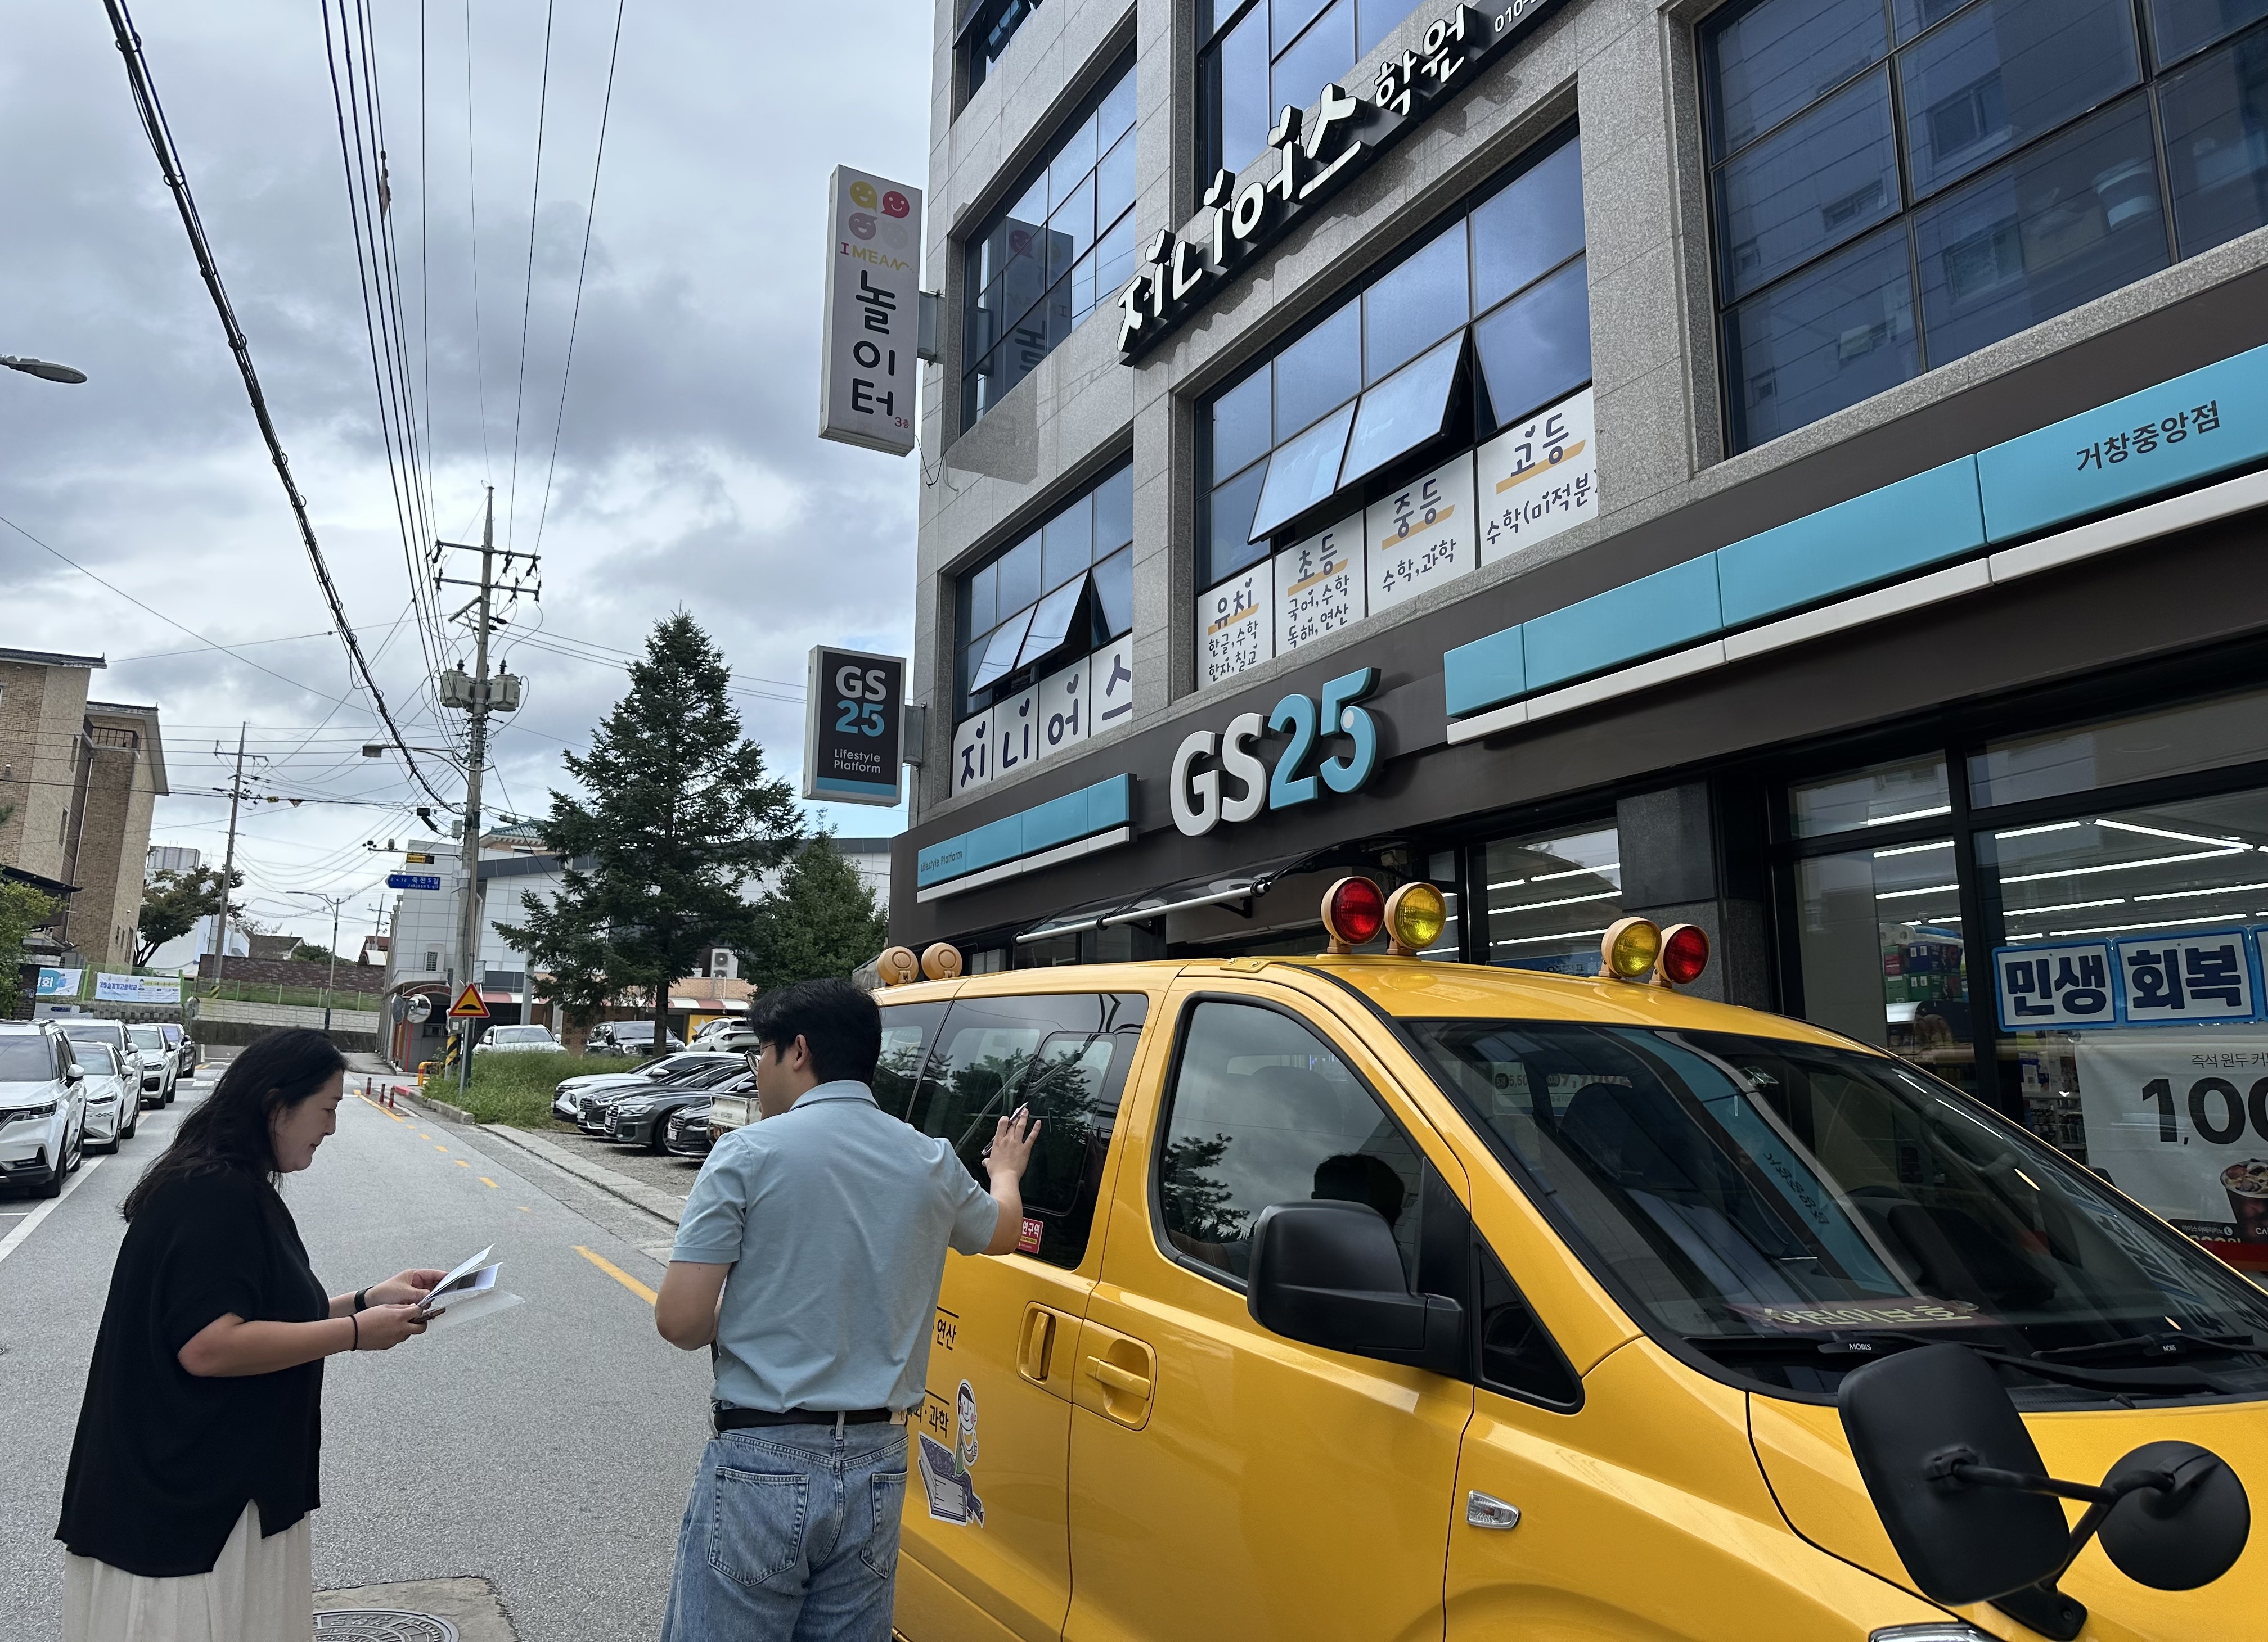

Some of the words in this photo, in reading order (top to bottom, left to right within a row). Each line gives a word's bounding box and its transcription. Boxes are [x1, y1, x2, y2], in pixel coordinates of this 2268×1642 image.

[1117, 82, 1361, 353] 지니어스
[1374, 3, 1465, 116] 학원
[852, 270, 897, 417] 놀이터
[895, 416, 910, 429] 3층
[1510, 412, 1569, 479] 고등
[2076, 400, 2221, 472] 거창중앙점
[1393, 477, 1442, 538] 중등
[1297, 533, 1337, 584] 초등
[1382, 539, 1456, 593] 수학,과학
[1214, 578, 1254, 630] 유치
[1287, 574, 1350, 621] 국어,수학
[1208, 620, 1258, 657] 한글,수학
[835, 665, 887, 701] GS
[835, 700, 886, 737] 25
[960, 653, 1132, 788] 지니어스
[834, 748, 881, 763] Lifestyle
[834, 759, 881, 774] Platform
[1170, 667, 1378, 836] GS25
[920, 857, 940, 872] Lifestyle
[940, 849, 962, 867] Platform
[2004, 954, 2107, 1016] 민생
[2127, 944, 2242, 1010] 회복
[1509, 1075, 1529, 1088] 5,50
[2191, 1053, 2218, 1068] 즉석
[2220, 1053, 2249, 1068] 원두
[1022, 1221, 1040, 1238] 연구역
